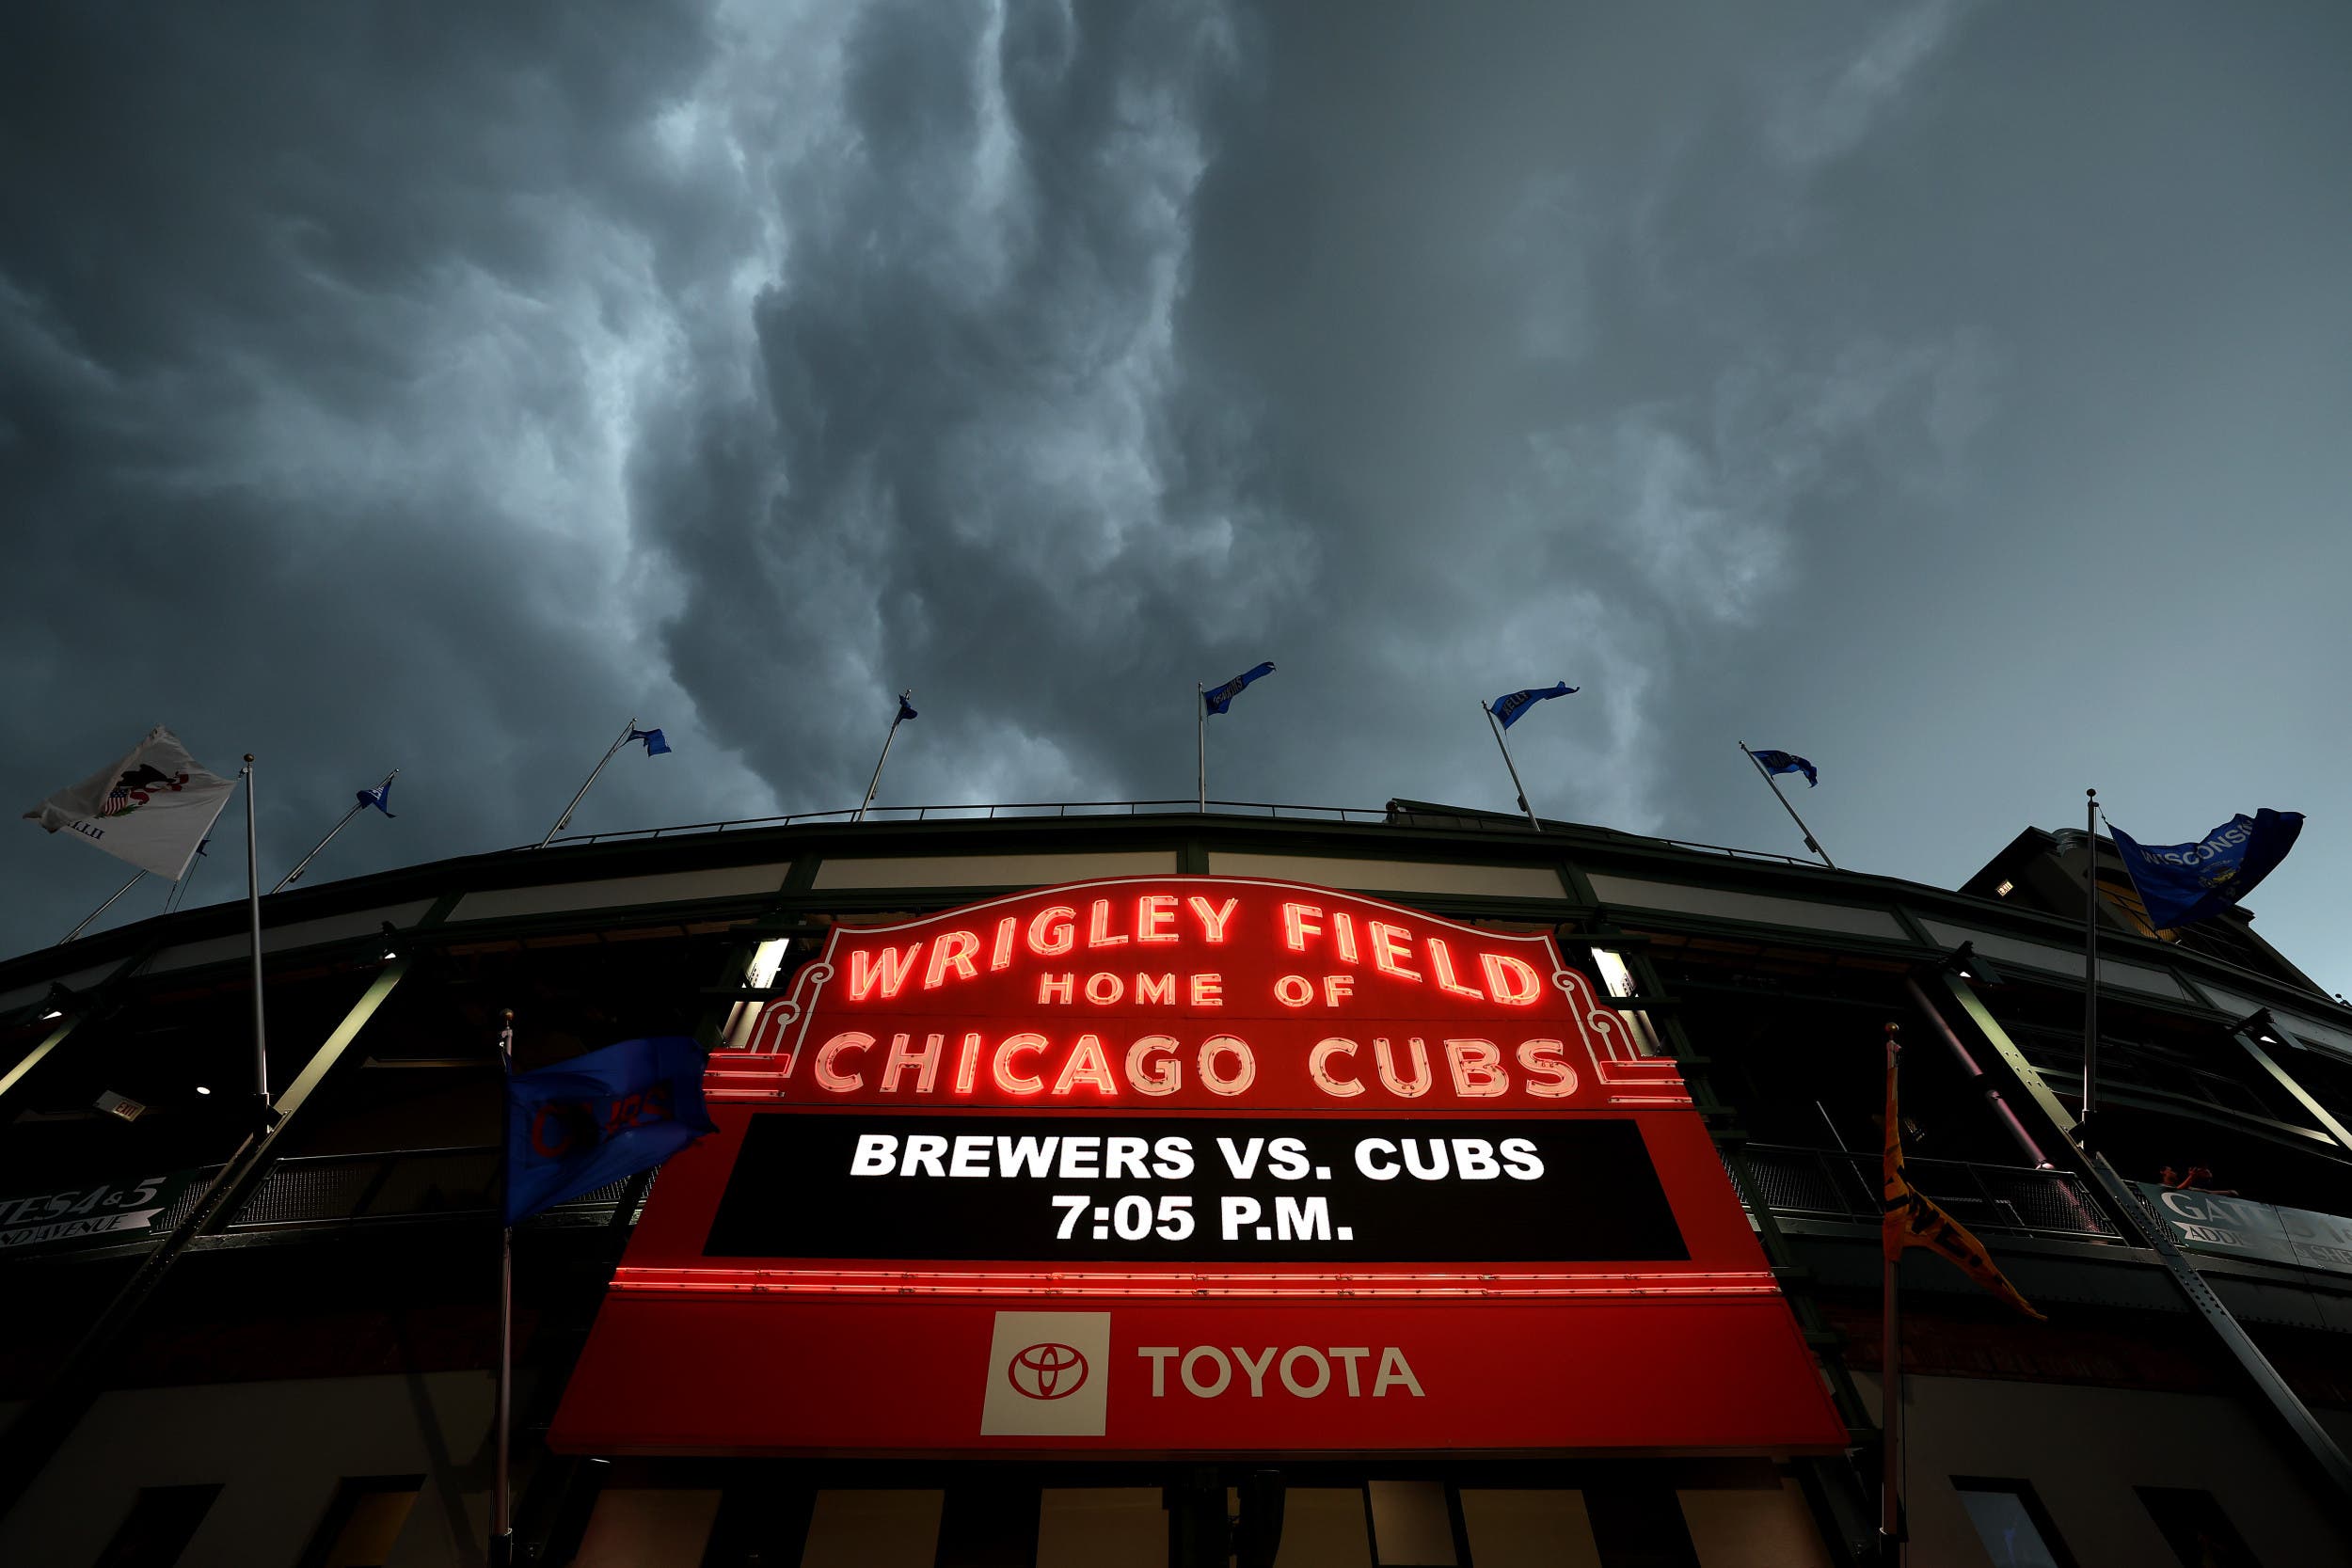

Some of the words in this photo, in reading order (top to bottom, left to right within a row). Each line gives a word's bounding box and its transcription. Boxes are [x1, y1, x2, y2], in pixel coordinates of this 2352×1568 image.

[849, 895, 1240, 1001] WRIGLEY
[1282, 901, 1541, 1006] FIELD
[1038, 972, 1223, 1006] HOME
[1274, 974, 1355, 1007] OF
[814, 1031, 1256, 1097] CHICAGO
[1308, 1037, 1579, 1098] CUBS
[850, 1134, 1196, 1180] BREWERS
[1216, 1137, 1331, 1180] VS.
[1354, 1138, 1546, 1180] CUBS
[1051, 1195, 1196, 1241] 7:05
[1221, 1196, 1353, 1241] P.M.
[1137, 1345, 1426, 1399] TOYOTA
